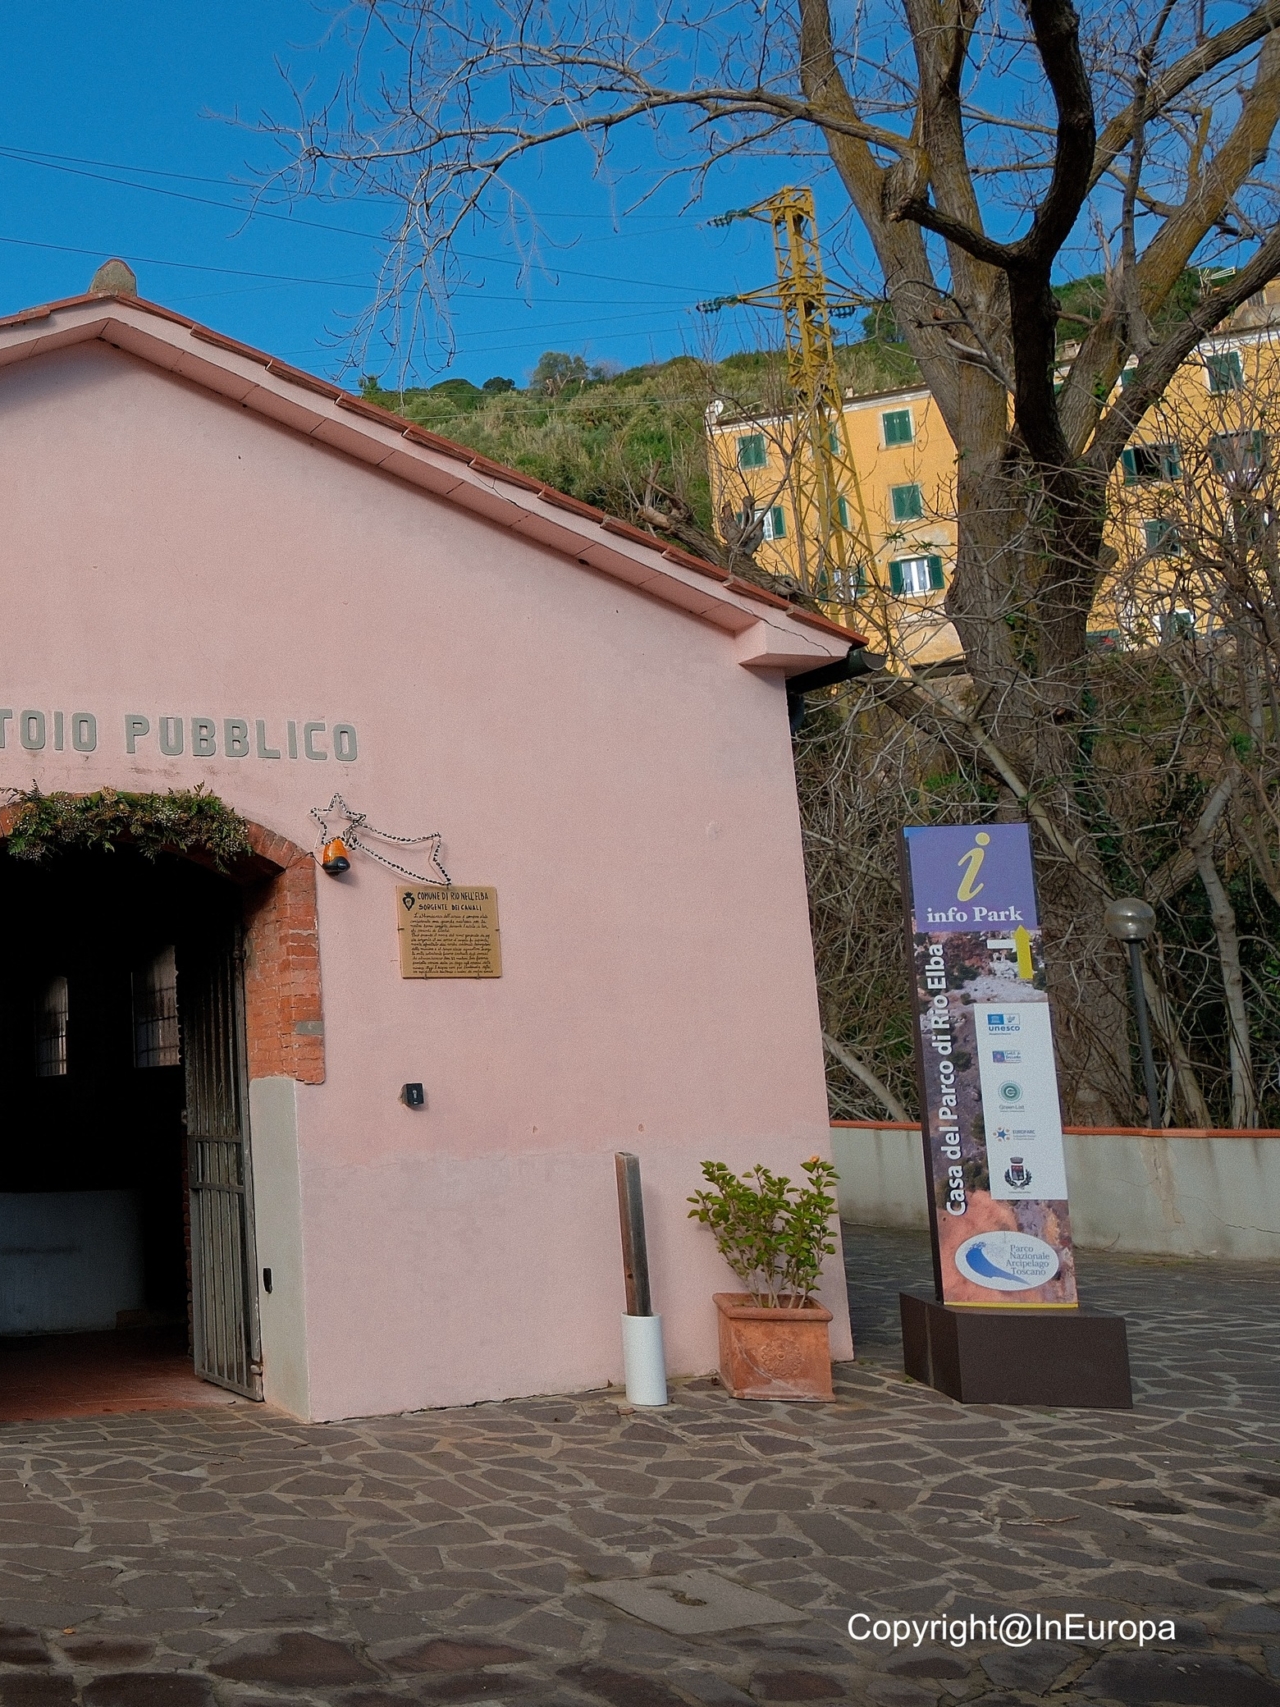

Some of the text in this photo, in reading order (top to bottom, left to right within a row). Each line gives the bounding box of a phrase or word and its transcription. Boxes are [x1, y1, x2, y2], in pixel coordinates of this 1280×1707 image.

[124, 713, 359, 763] PUBBLICO
[417, 892, 440, 900] COMUNE
[441, 892, 448, 900] DI
[451, 892, 460, 900] RIO
[927, 905, 1024, 922] info Park
[924, 944, 966, 1216] Casa del Parco di Rio Elba
[1010, 1244, 1034, 1252] Parco
[1010, 1252, 1050, 1260] Nazionale
[1006, 1260, 1050, 1269] Arcipelago
[1010, 1267, 1046, 1275] Toscano
